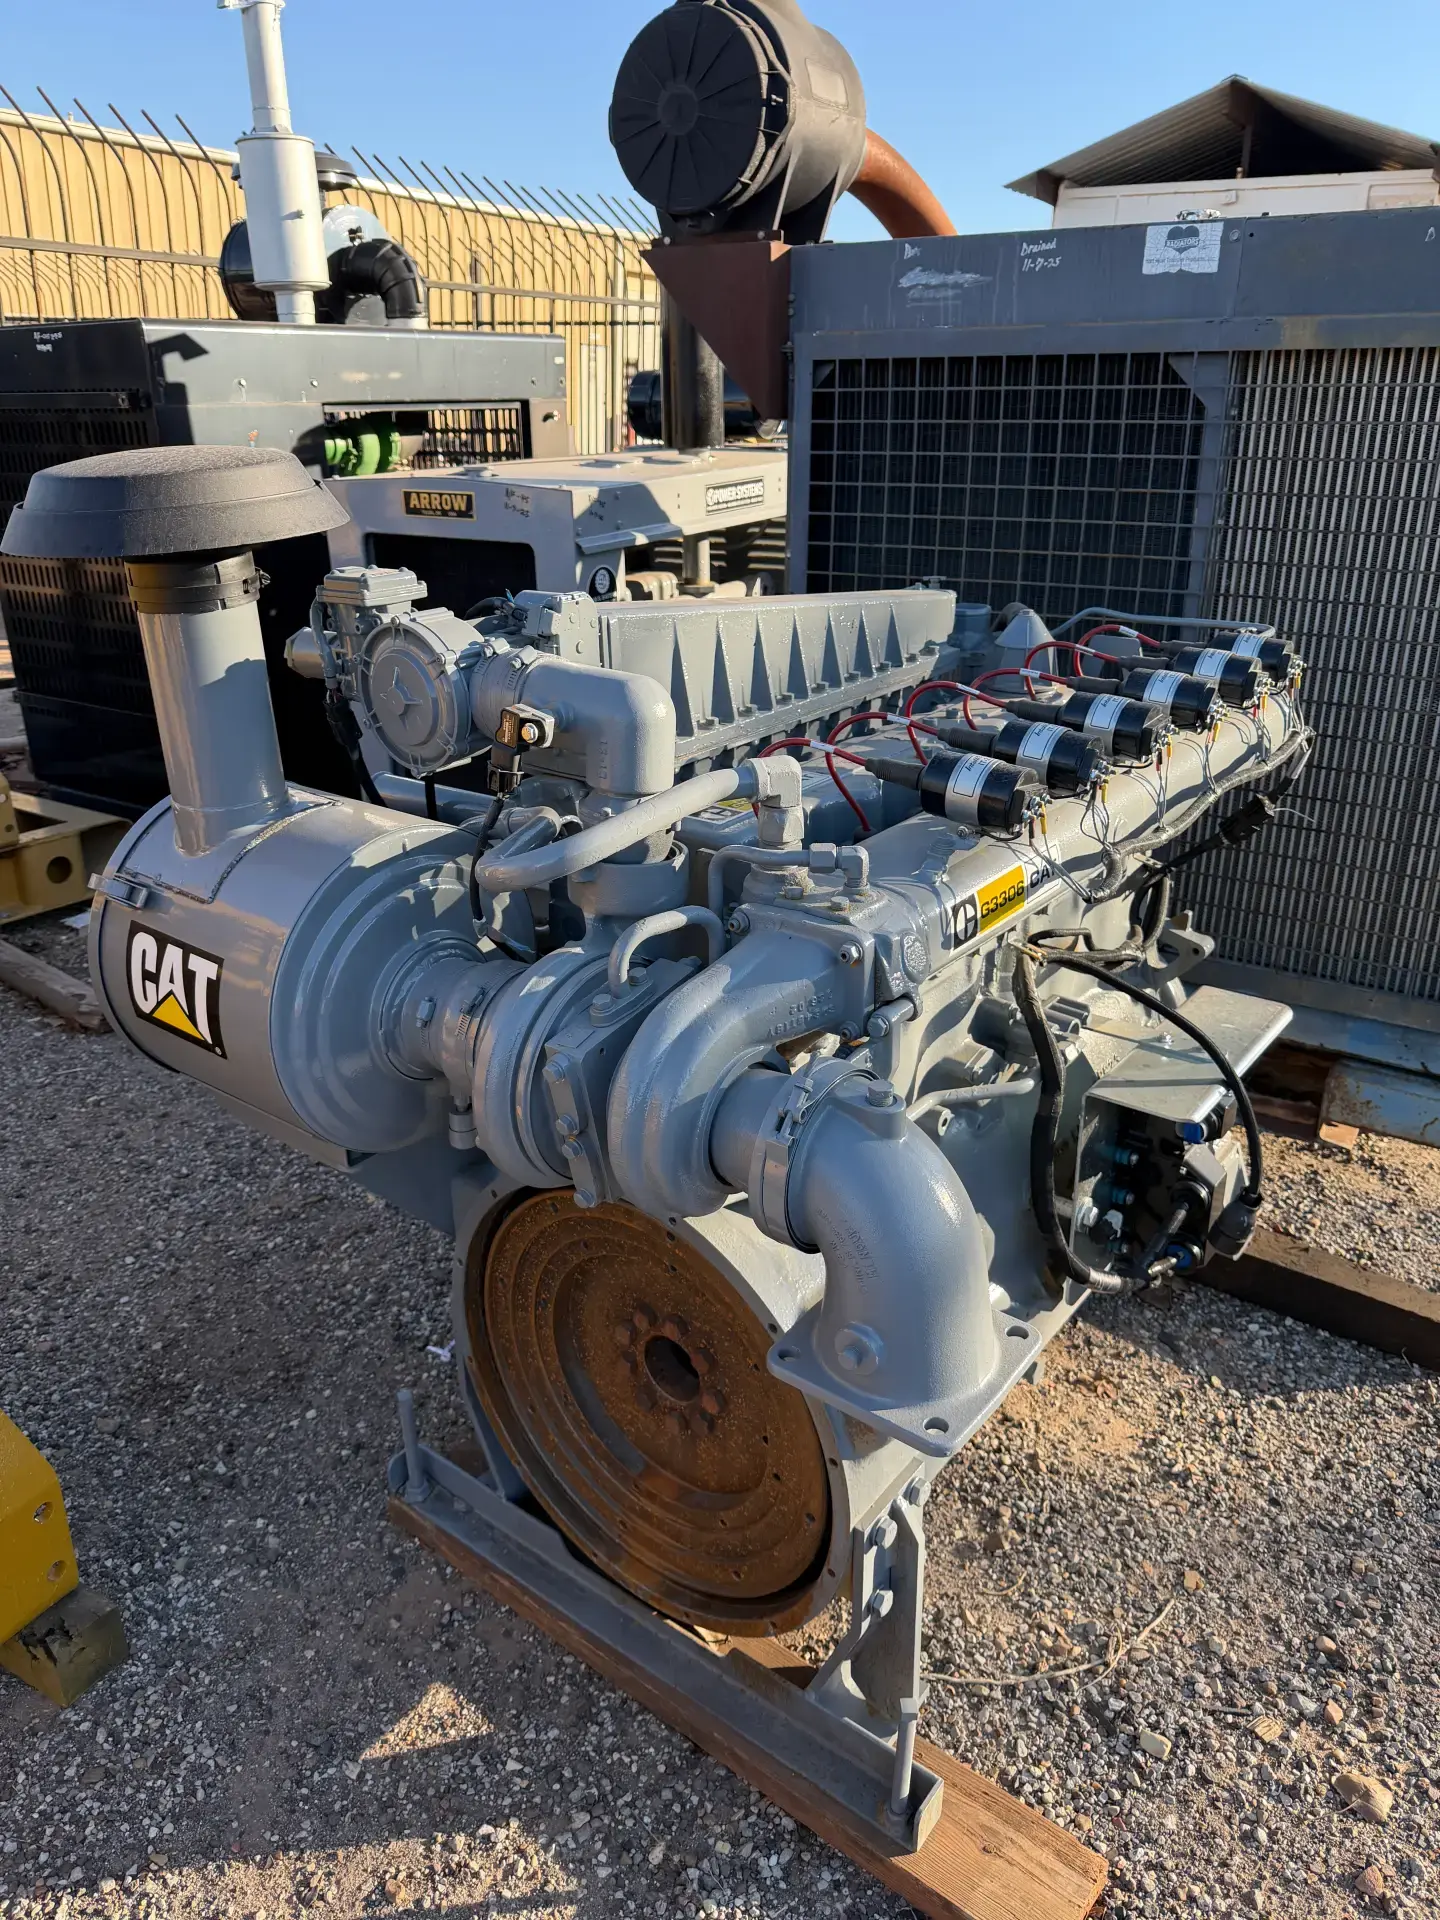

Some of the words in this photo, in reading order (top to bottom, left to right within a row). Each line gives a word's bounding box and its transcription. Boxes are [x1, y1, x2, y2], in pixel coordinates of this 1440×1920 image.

[1166, 237, 1200, 248] RADIATORS
[409, 492, 468, 511] ARROW
[980, 880, 1025, 918] G3306
[130, 931, 219, 1045] CAT
